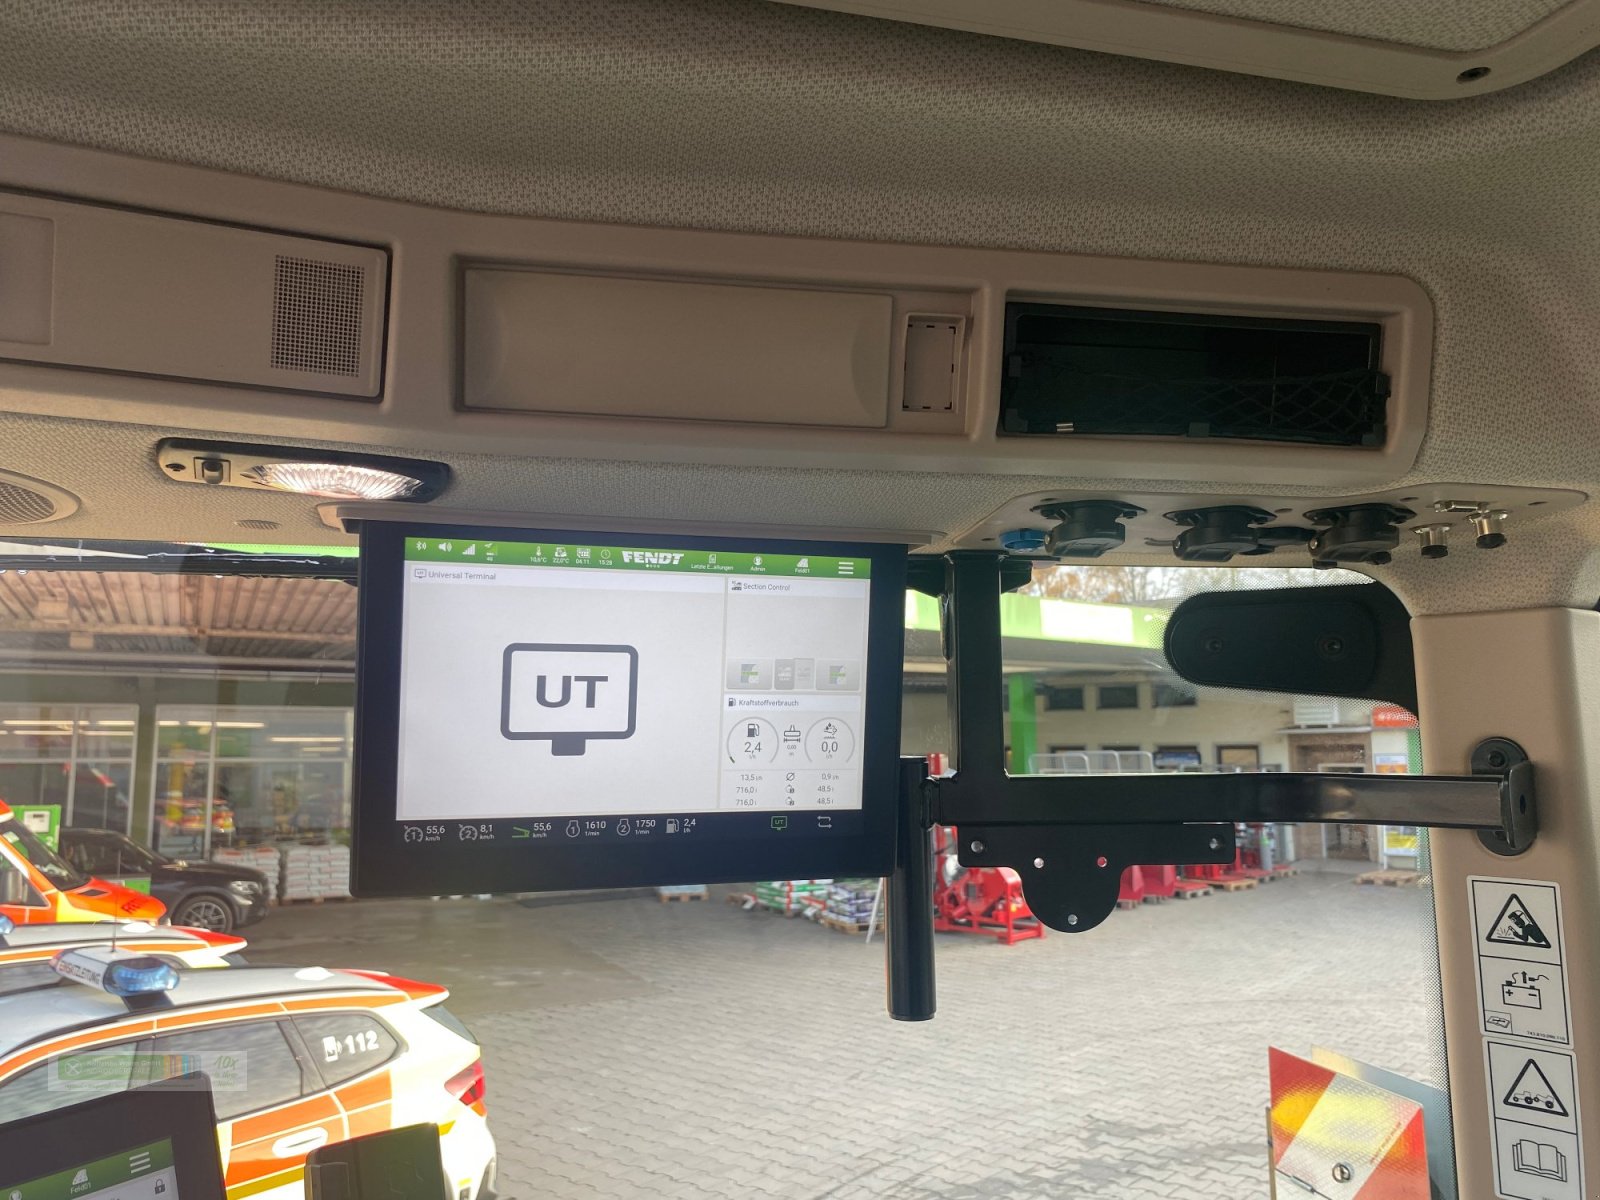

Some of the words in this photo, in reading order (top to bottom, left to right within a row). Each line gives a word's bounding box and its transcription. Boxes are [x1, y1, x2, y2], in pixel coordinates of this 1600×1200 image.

[622, 550, 684, 566] FENDT
[428, 571, 463, 580] Universal
[465, 572, 496, 580] Terminal
[743, 582, 767, 591] Section
[767, 583, 791, 592] Control
[536, 675, 608, 708] UT
[738, 699, 799, 708] Kraftstoffverbrauch
[744, 741, 763, 754] 2,4
[821, 741, 839, 754] 0,0
[740, 774, 755, 782] 13,5
[821, 773, 832, 781] 0,9
[736, 786, 755, 794] 716,0
[735, 799, 754, 807] 716,0
[817, 797, 831, 806] 48,5
[533, 822, 552, 832] 55,6
[585, 821, 606, 830] 1610
[620, 823, 628, 833] 2
[635, 819, 656, 828] 1750
[683, 818, 697, 828] 2,4
[426, 825, 446, 836] 55,6
[480, 824, 493, 834] 8,1
[344, 1030, 379, 1054] 112
